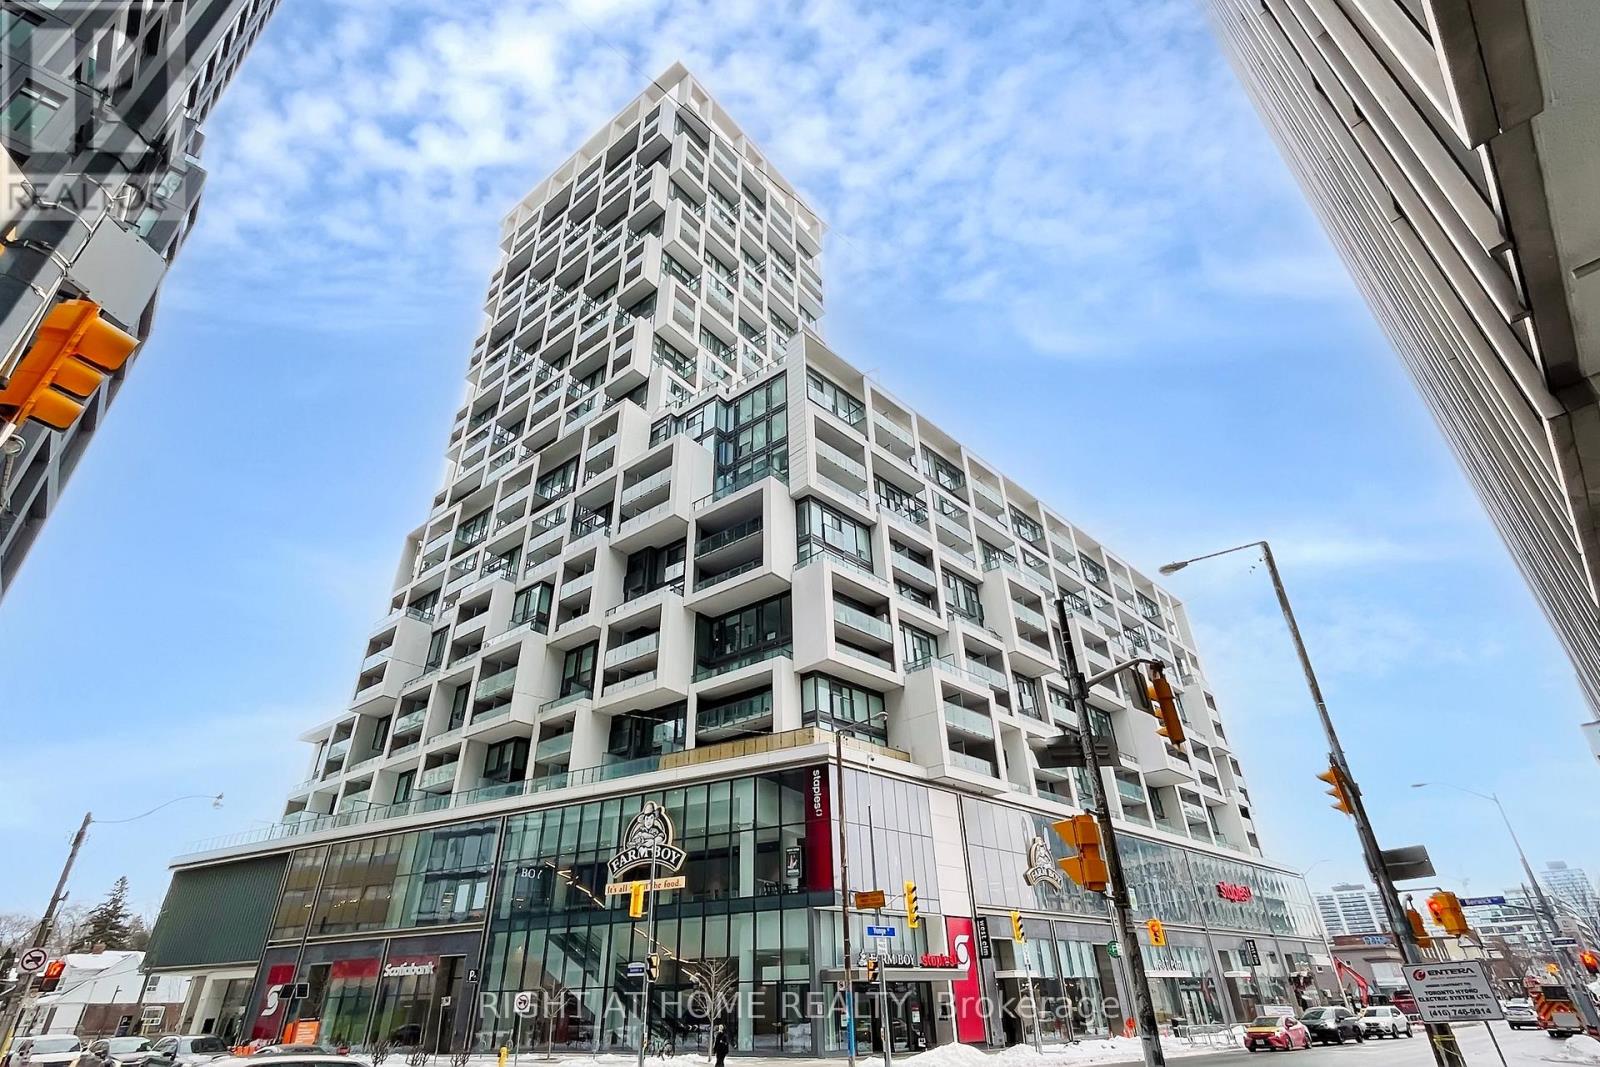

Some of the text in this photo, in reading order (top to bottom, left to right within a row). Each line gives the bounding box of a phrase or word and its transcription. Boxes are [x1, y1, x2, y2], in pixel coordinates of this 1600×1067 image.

[812, 769, 822, 810] staples
[611, 845, 681, 873] FARM BOY
[619, 884, 628, 892] all
[979, 921, 987, 940] west
[898, 953, 915, 965] BOY
[384, 962, 435, 977] Scotiabank
[1428, 968, 1475, 976] ENTERA
